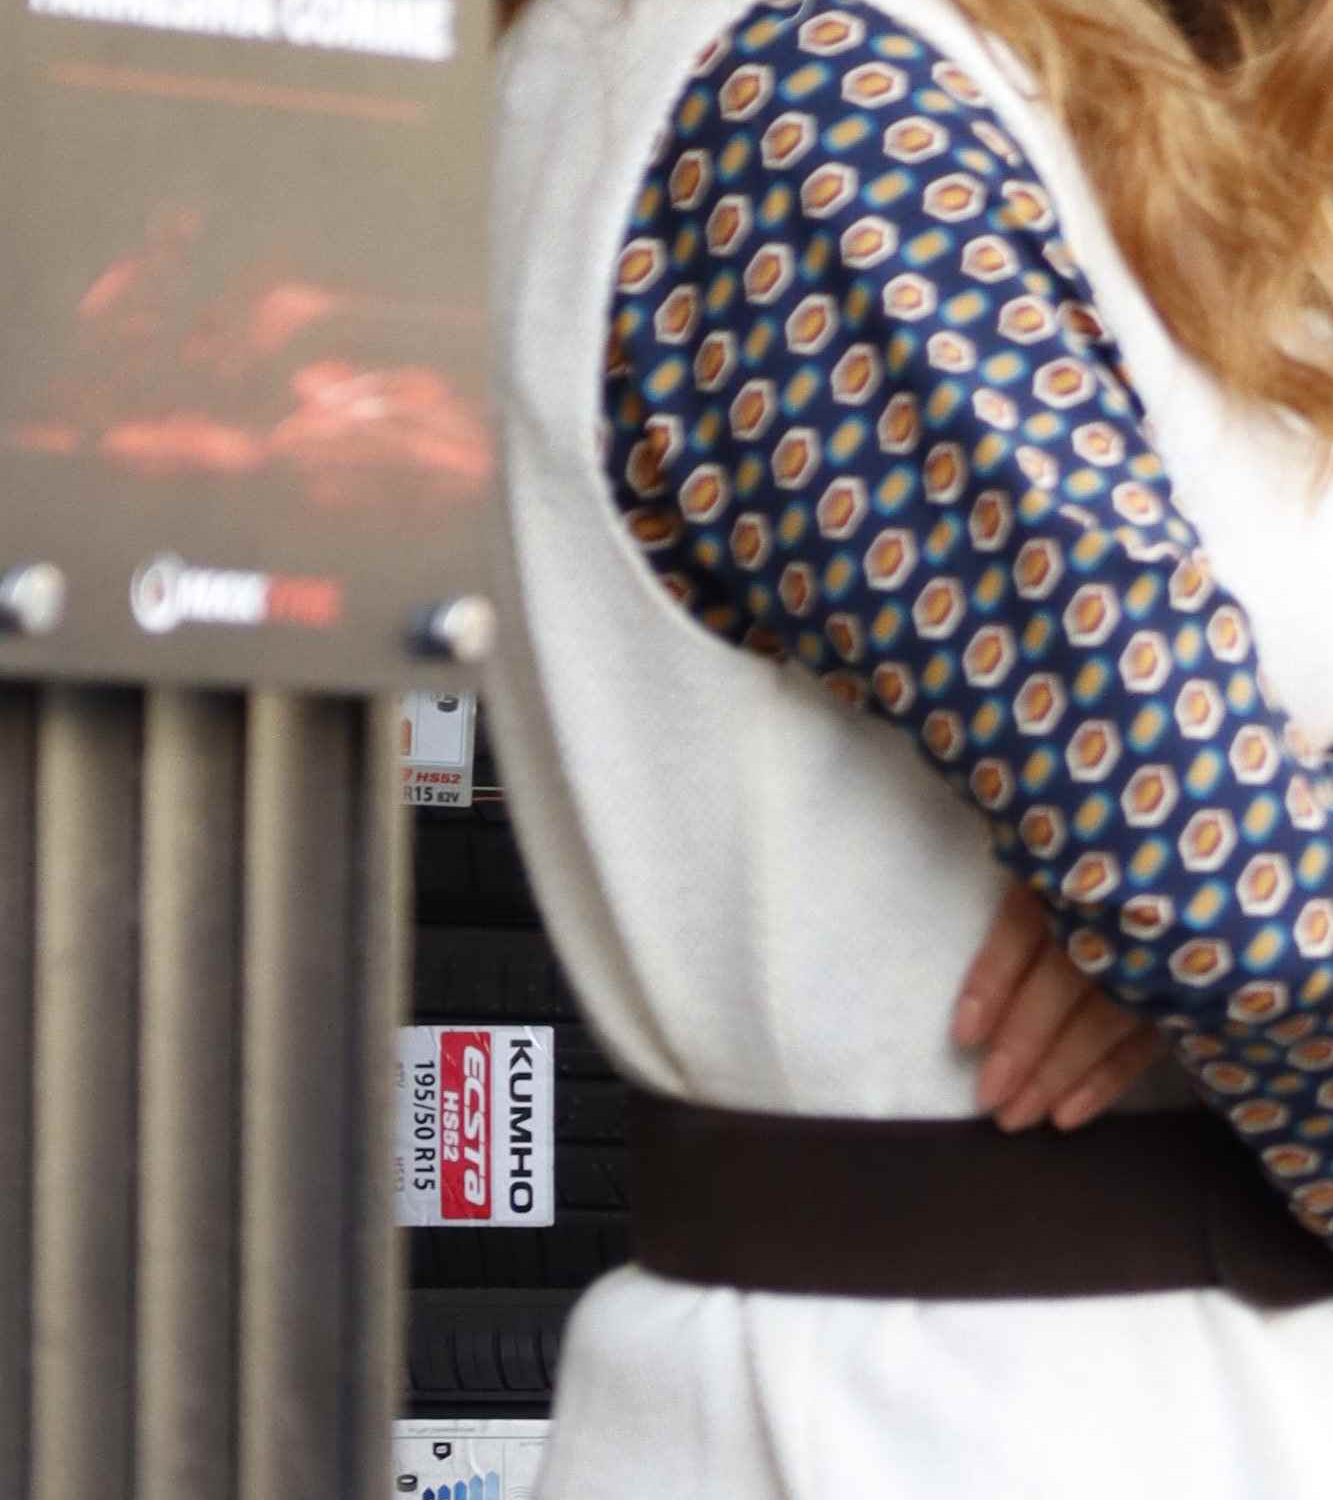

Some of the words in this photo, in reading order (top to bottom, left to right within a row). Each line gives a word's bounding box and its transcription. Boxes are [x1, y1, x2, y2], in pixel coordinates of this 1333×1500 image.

[413, 1061, 436, 1141] 195/50
[509, 1039, 533, 1214] KUMHO
[413, 1147, 436, 1191] R15
